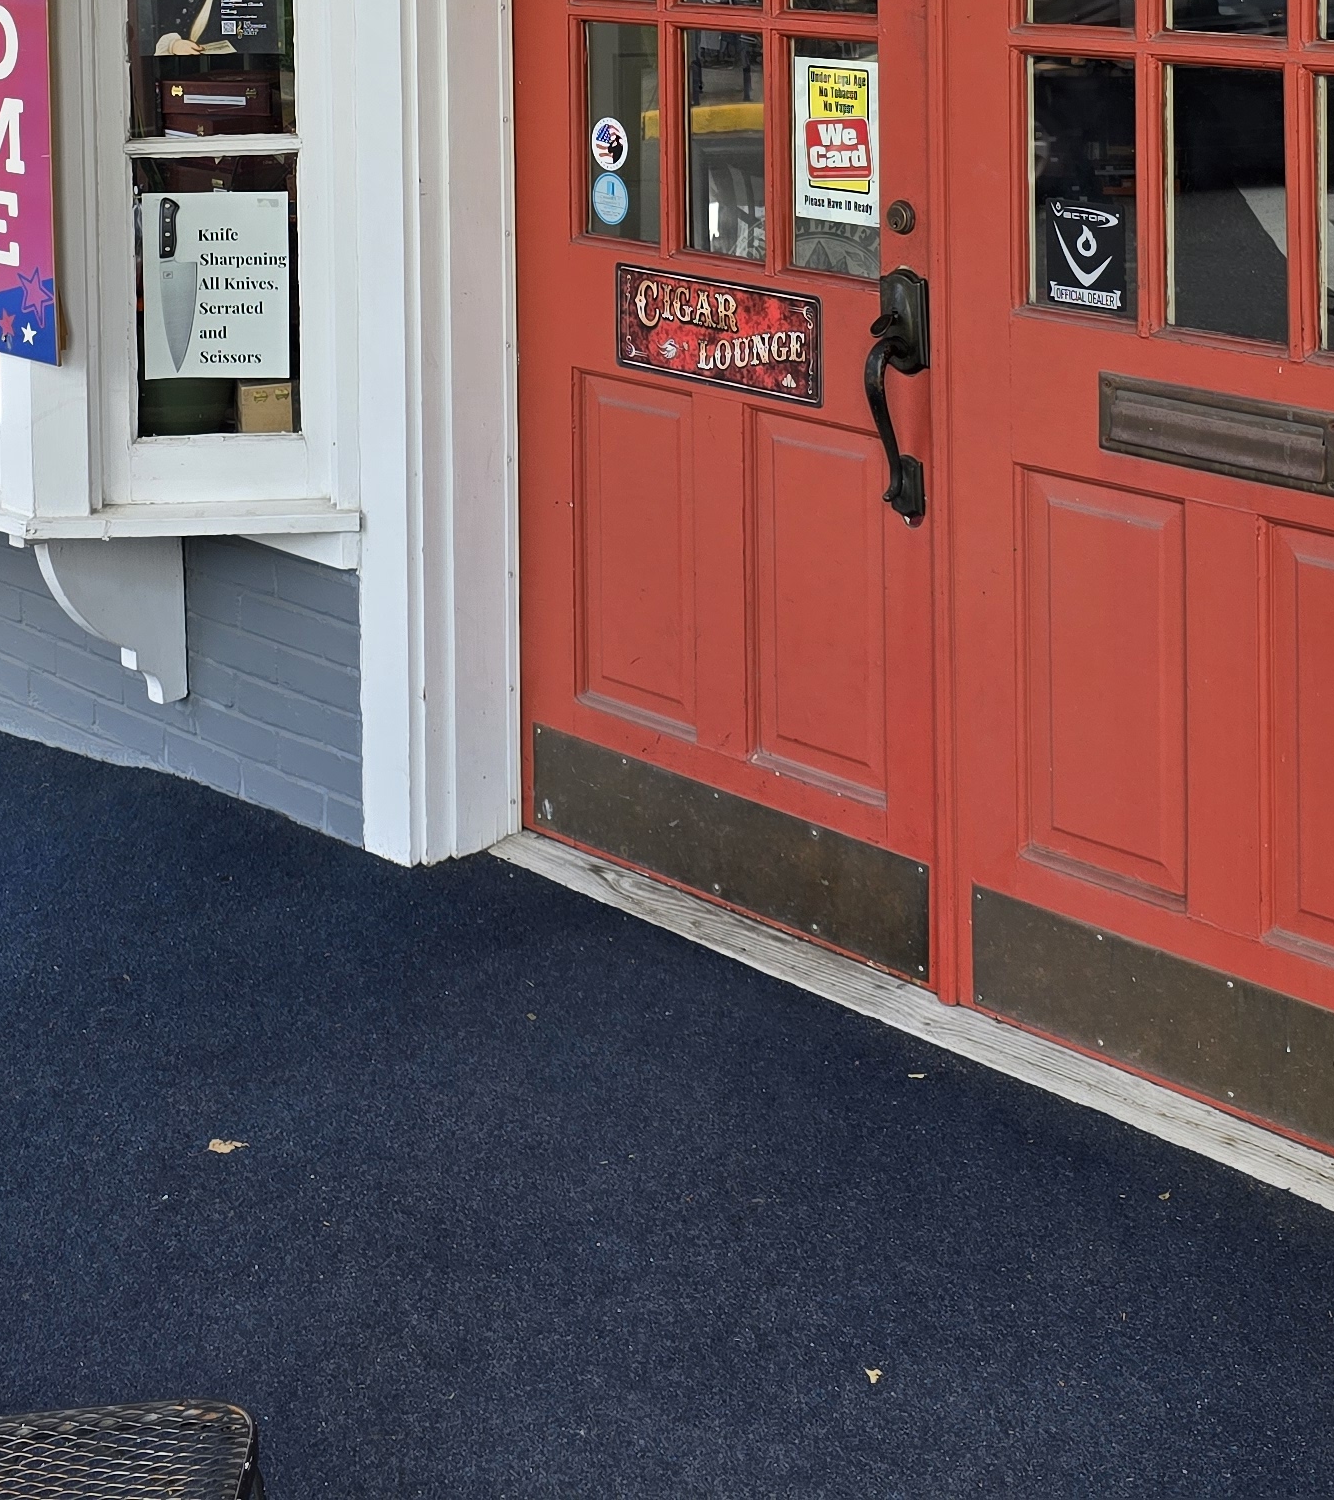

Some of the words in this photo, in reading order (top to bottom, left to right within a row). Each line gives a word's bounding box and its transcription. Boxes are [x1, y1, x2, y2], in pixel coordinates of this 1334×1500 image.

[810, 71, 831, 84] Under
[853, 73, 866, 88] Age
[819, 86, 828, 98] No
[823, 100, 833, 112] No
[818, 123, 857, 145] We
[809, 145, 867, 168] Card
[804, 194, 825, 208] Please
[827, 197, 843, 210] Have
[845, 199, 851, 211] ID
[854, 201, 873, 215] Ready
[197, 228, 239, 242] Knife
[199, 252, 287, 268] Sharpening
[198, 277, 220, 290] All
[224, 277, 279, 292] Knives,
[1056, 287, 1086, 303] OFFICIAL
[1087, 290, 1115, 307] DEALER
[199, 301, 264, 315] Serrated
[634, 279, 739, 332] CIGAR
[199, 325, 228, 339] and
[199, 349, 262, 364] Scissors
[697, 331, 806, 370] LOUNGE
